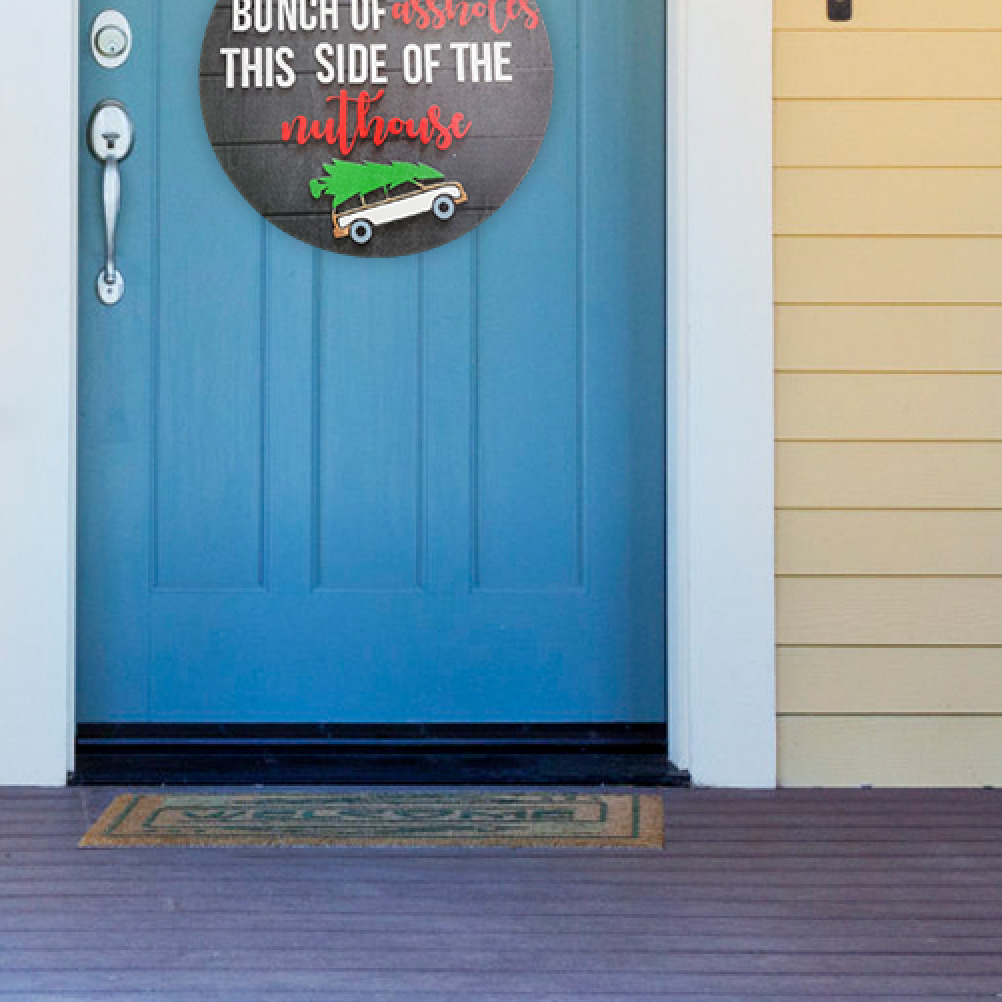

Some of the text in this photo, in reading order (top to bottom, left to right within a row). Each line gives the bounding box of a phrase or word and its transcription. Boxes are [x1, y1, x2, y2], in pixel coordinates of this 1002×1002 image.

[219, 41, 513, 89] THIS SIDE OF THE
[281, 89, 472, 156] nuthouse
